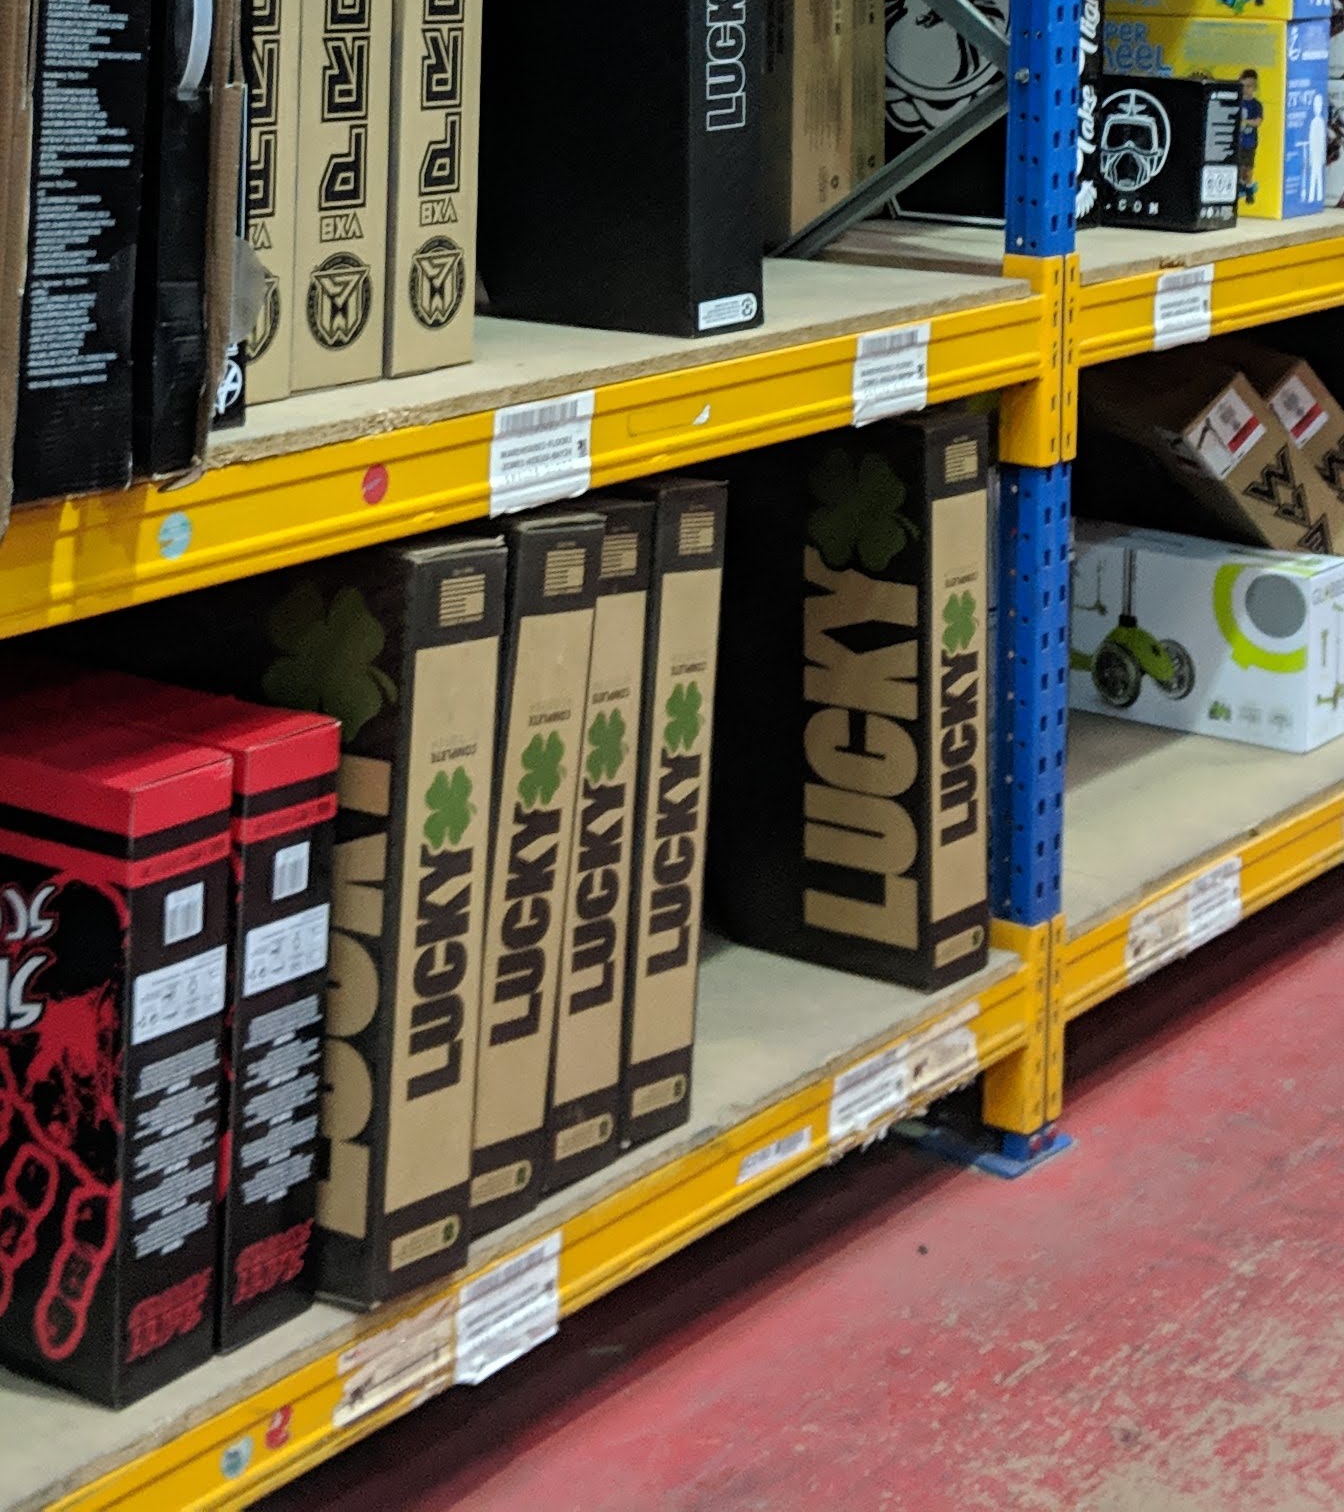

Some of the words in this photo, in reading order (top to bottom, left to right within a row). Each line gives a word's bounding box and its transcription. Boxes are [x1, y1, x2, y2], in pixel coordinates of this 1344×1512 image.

[321, 215, 363, 244] VX8
[419, 197, 457, 227] VX8
[430, 743, 478, 765] COMPLETE
[528, 710, 571, 727] COMPLETE
[803, 544, 919, 952] LUCKY
[940, 650, 979, 846] LUCKY
[490, 803, 565, 1049] LUCKY
[567, 778, 626, 1017] LUCKY
[646, 750, 703, 978] LUCKY
[406, 844, 470, 1103] LUCKY
